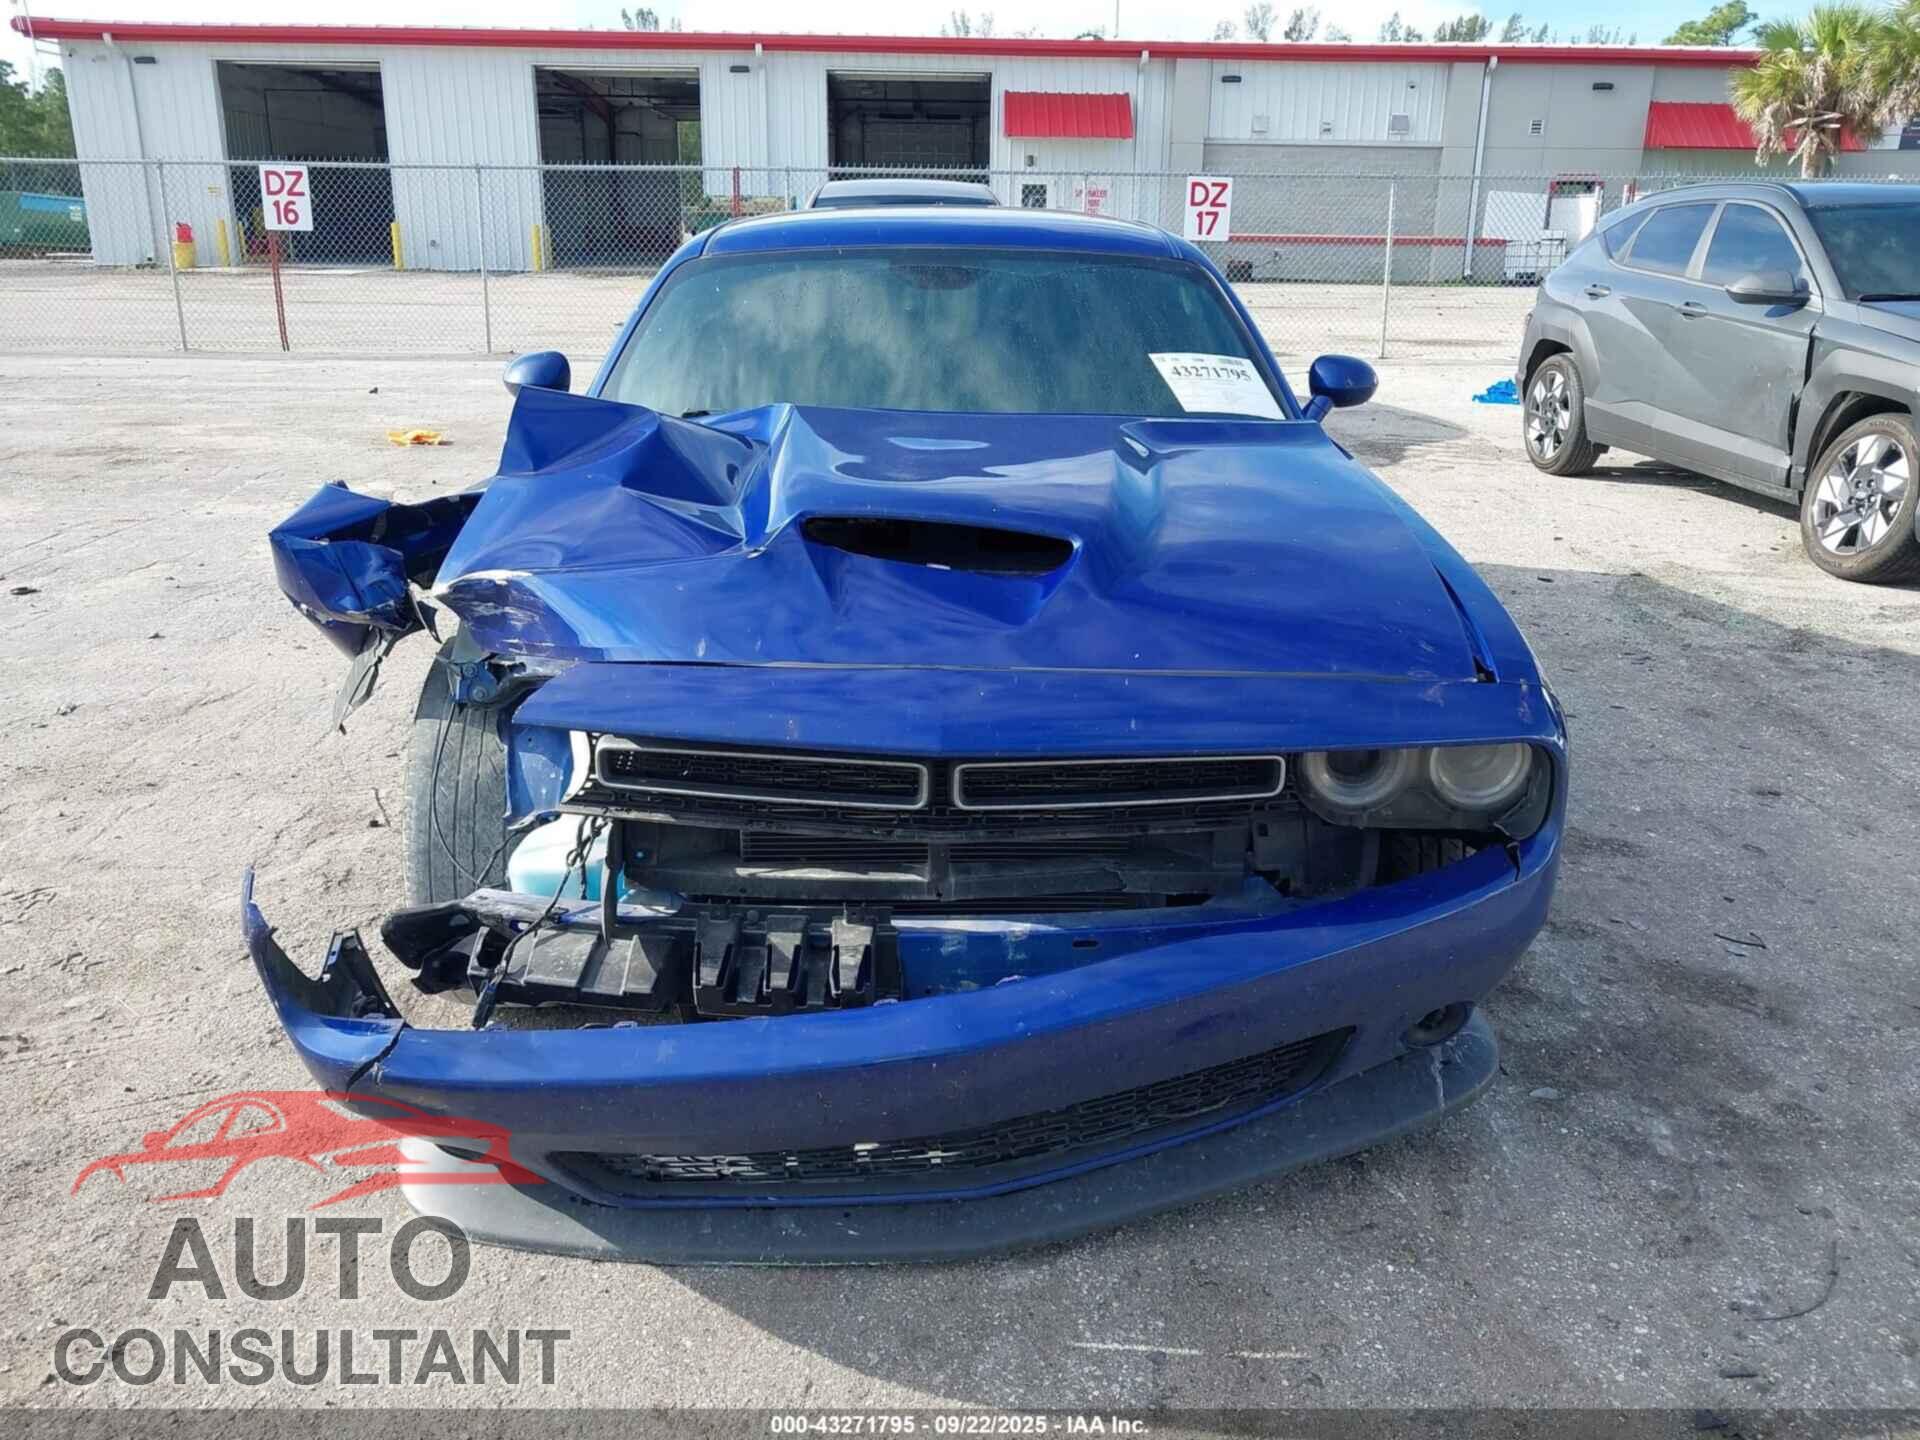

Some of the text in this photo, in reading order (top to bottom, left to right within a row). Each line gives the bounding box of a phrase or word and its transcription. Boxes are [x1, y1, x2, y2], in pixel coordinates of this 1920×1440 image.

[264, 170, 305, 196] DZ
[1190, 182, 1228, 207] DZ
[272, 200, 300, 225] 16
[1196, 211, 1219, 235] 17
[1171, 365, 1251, 382] 43271795
